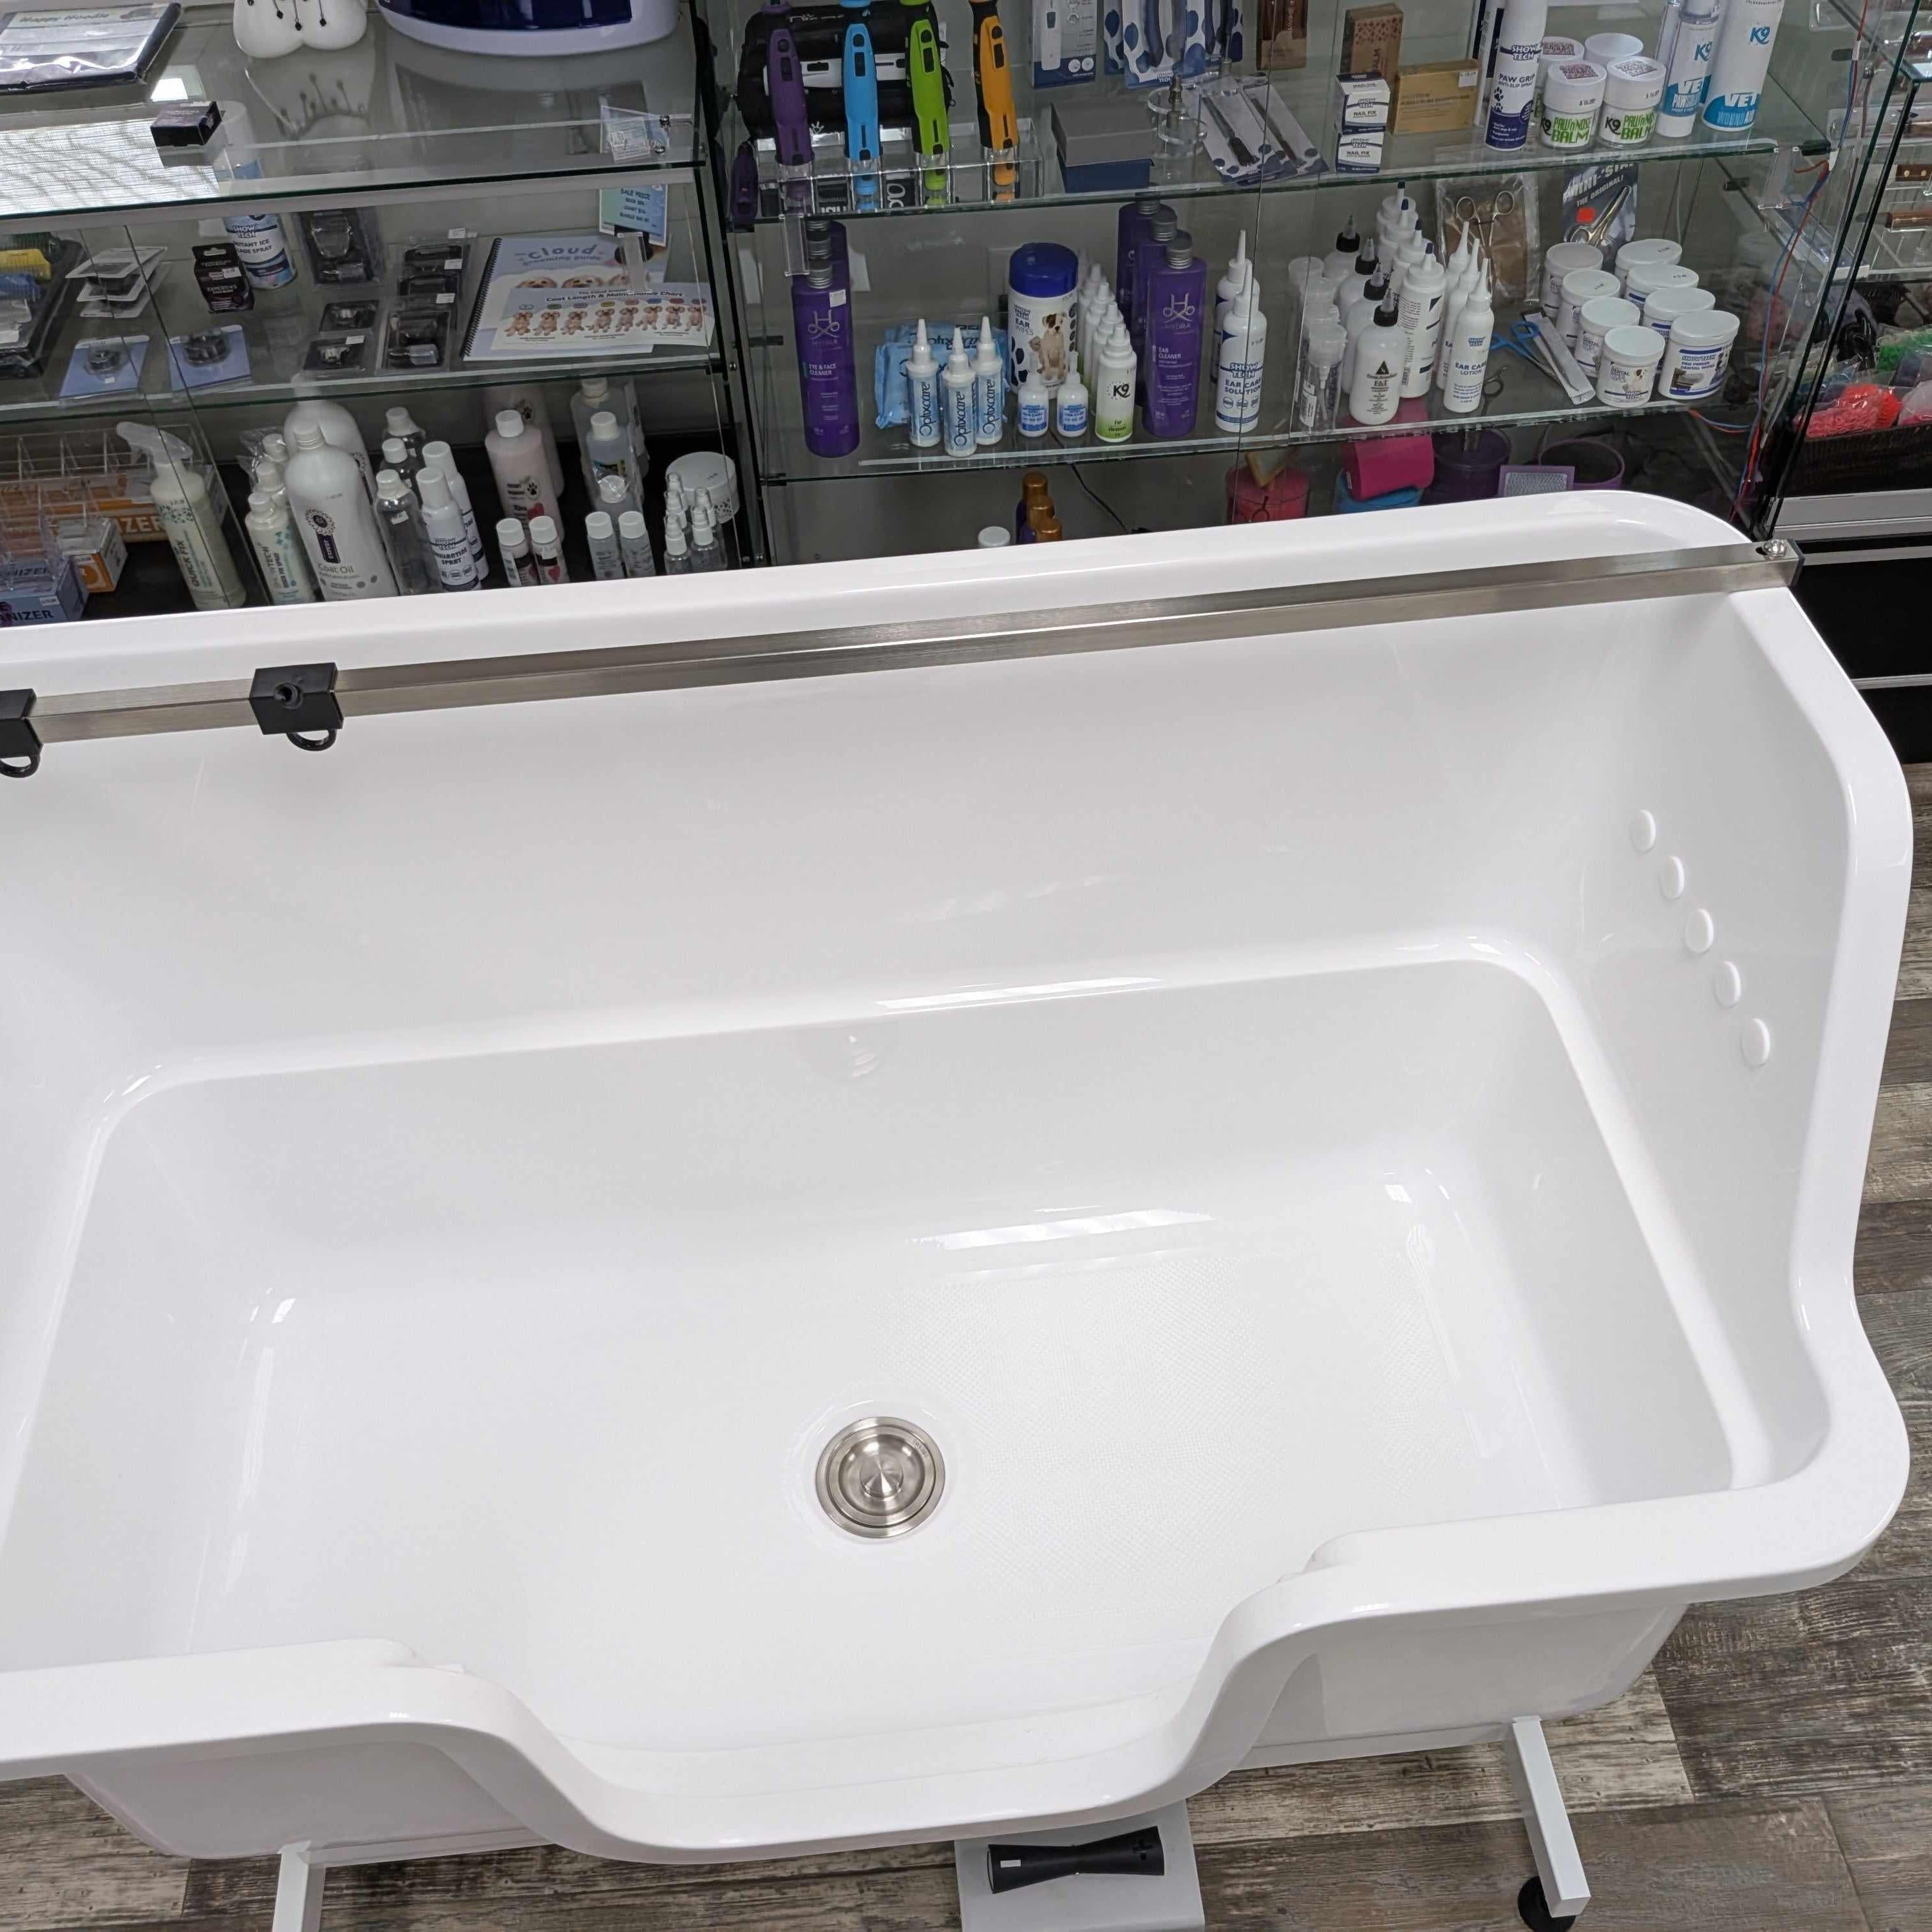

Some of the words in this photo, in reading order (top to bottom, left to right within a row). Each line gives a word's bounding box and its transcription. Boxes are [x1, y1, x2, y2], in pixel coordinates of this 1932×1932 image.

[1750, 26, 1770, 44] K9
[1694, 41, 1712, 61] K9
[1499, 73, 1517, 83] PAW
[1605, 117, 1621, 135] K9
[1551, 128, 1589, 144] BALM
[1015, 318, 1030, 328] EAR
[1230, 363, 1258, 372] SHOW
[1455, 362, 1469, 370] EAR
[1472, 361, 1486, 370] CAR
[1611, 367, 1630, 377] DENTAL
[1113, 383, 1132, 398] K9
[954, 392, 972, 447] Optixcare
[176, 540, 189, 556] FIX
[318, 563, 339, 573] Coat
[339, 564, 355, 574] Oil
